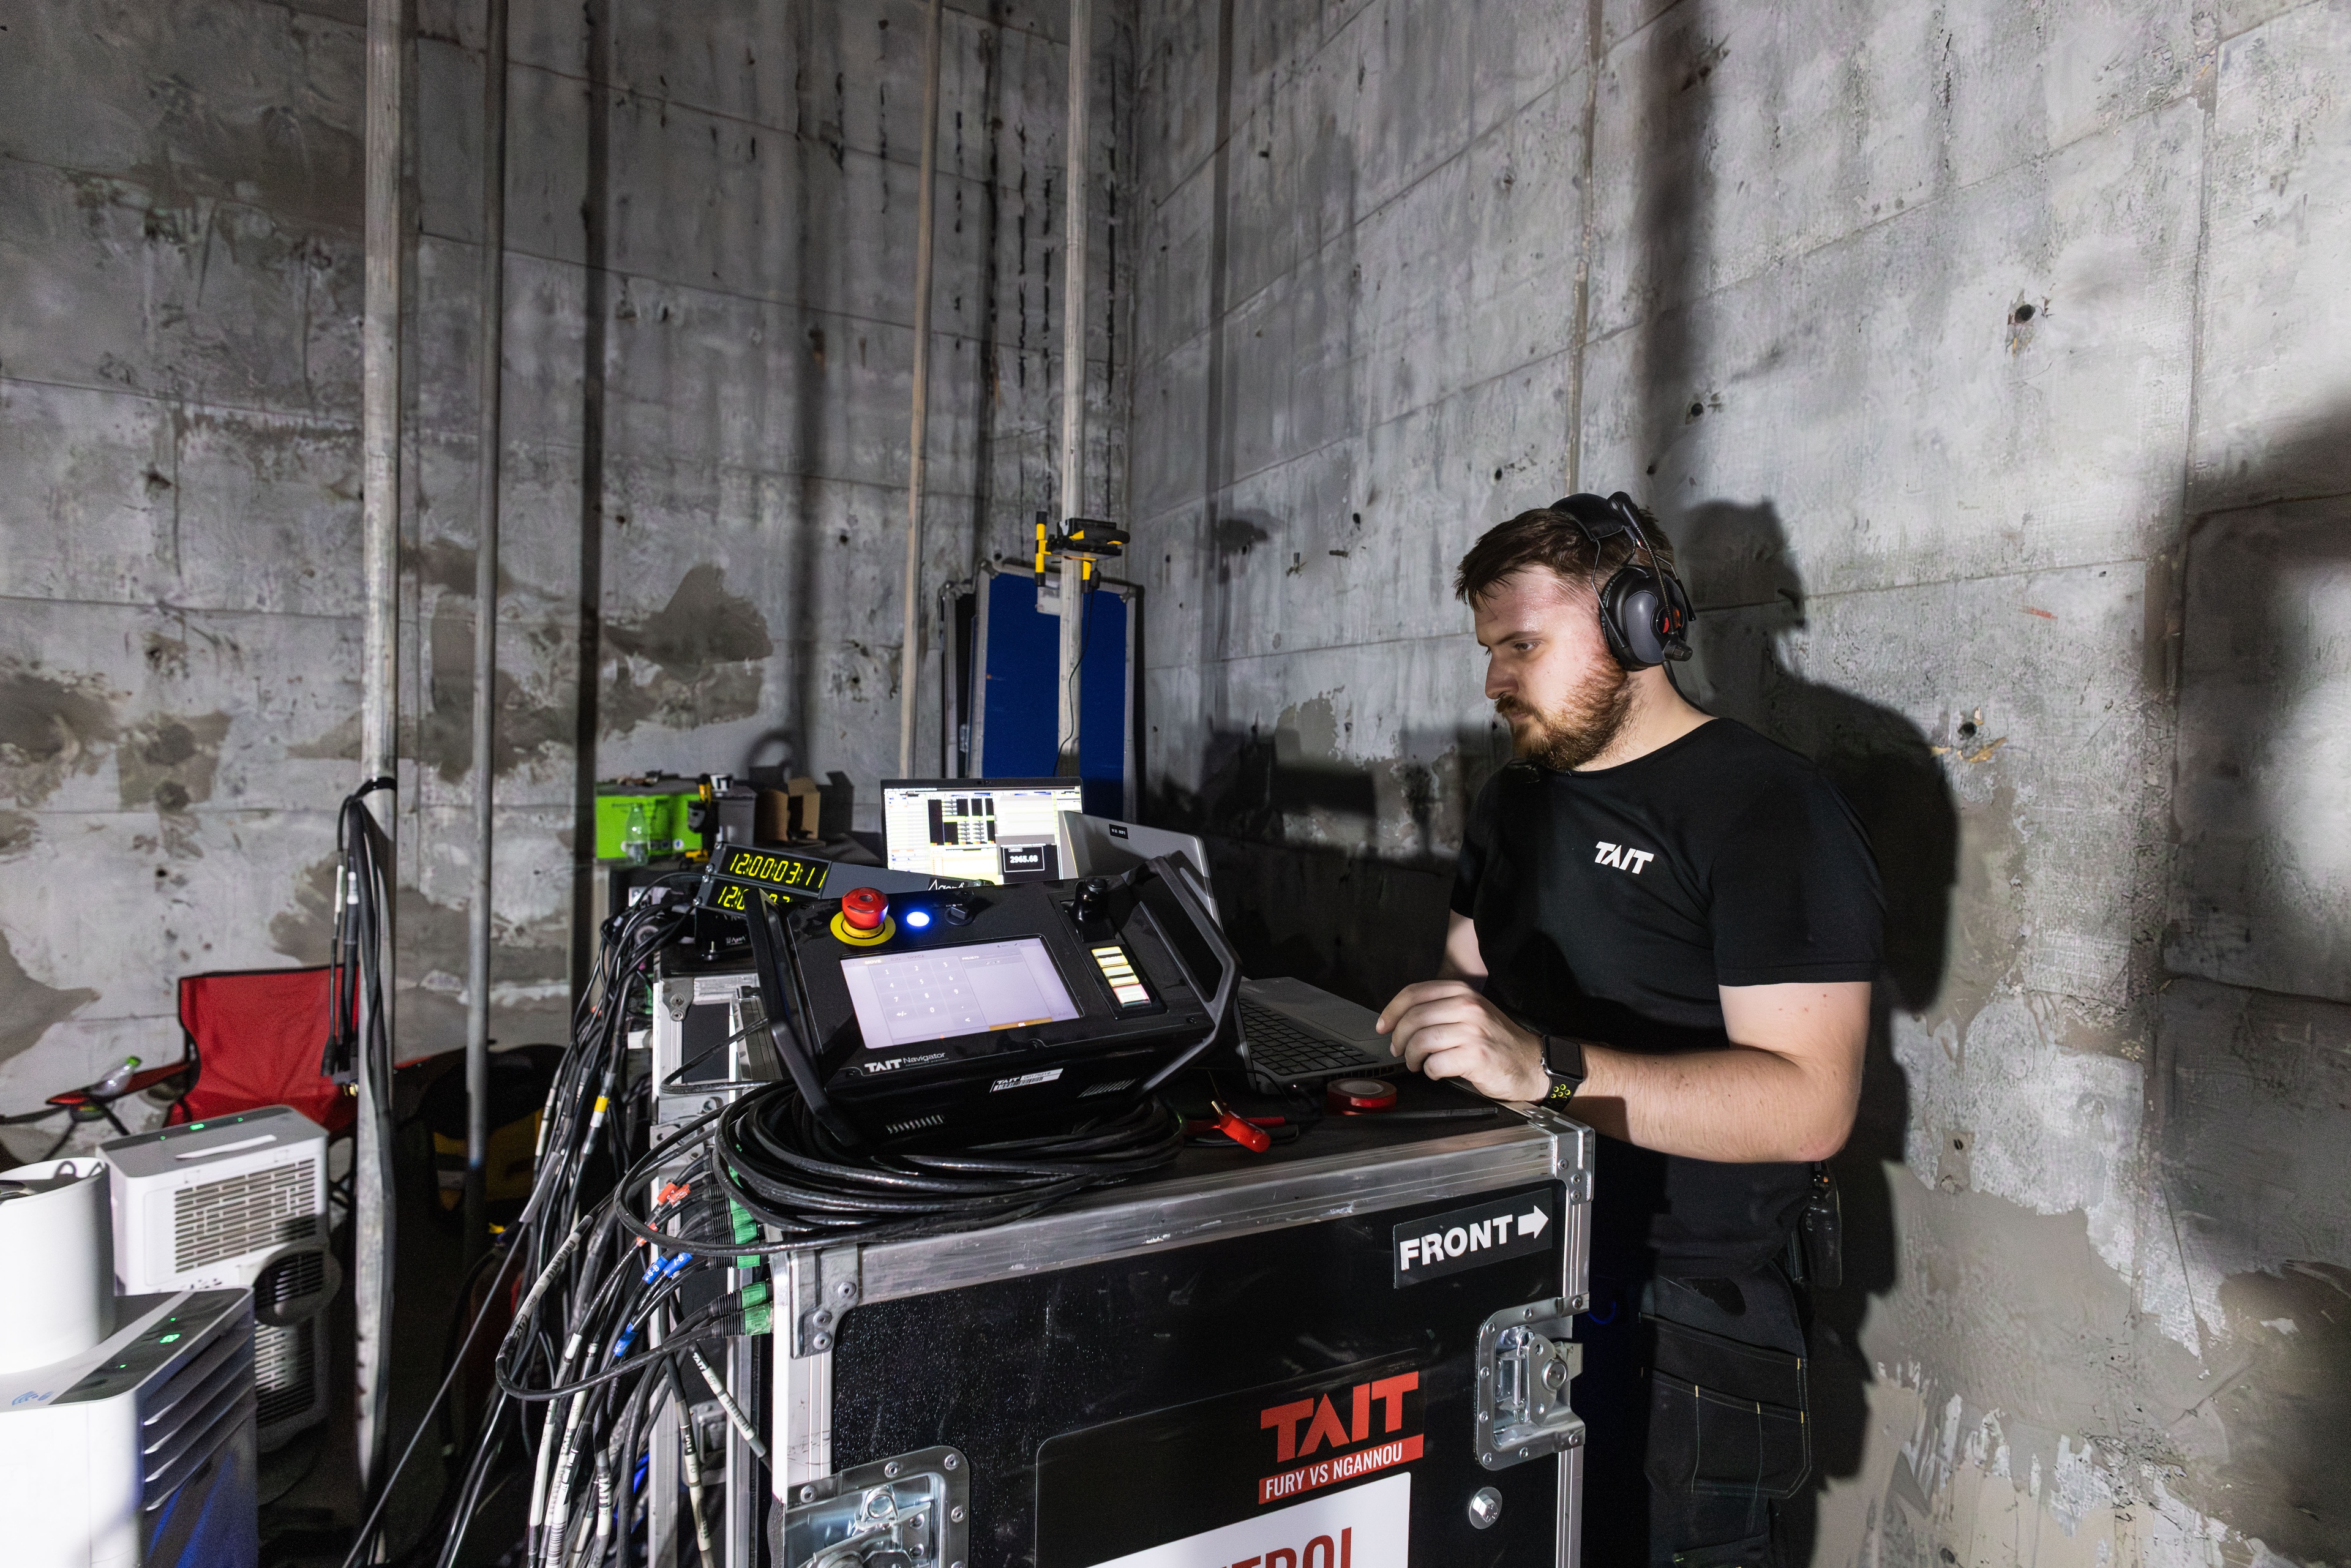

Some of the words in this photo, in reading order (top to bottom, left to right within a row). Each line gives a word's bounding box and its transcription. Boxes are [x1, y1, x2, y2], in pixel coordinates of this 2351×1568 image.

[1594, 841, 1655, 875] TAIT
[864, 1058, 902, 1073] TAIT
[902, 1052, 946, 1064] Navigator
[996, 1076, 1021, 1085] TAIT
[1400, 1214, 1513, 1271] FRONT
[692, 1352, 710, 1371] TAIT
[1260, 1370, 1419, 1463] TAIT
[1265, 1469, 1305, 1499] FURY
[1309, 1463, 1329, 1486] VS
[1333, 1442, 1403, 1480] NGANNOU
[599, 1477, 612, 1506] TAIT
